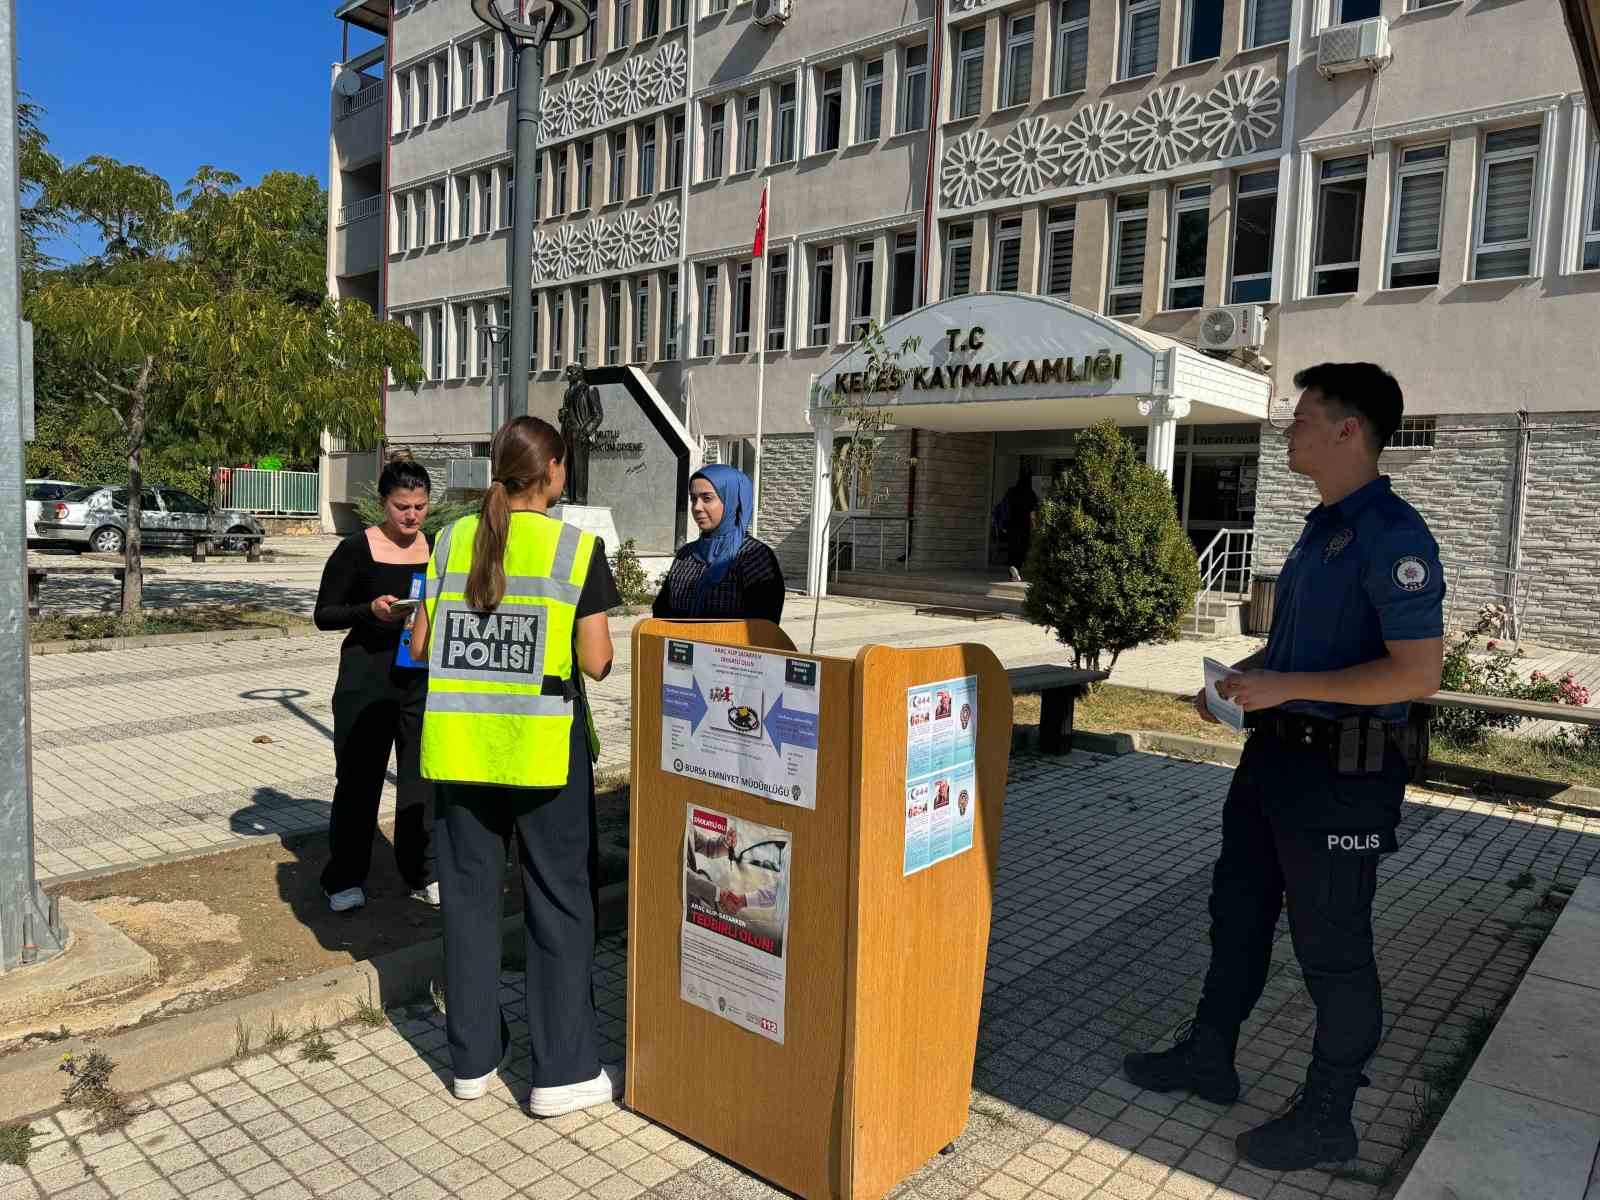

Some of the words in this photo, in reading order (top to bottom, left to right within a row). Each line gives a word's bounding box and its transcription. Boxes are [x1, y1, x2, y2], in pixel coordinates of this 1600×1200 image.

[945, 326, 985, 352] T.C
[912, 349, 1123, 390] KAYMAKAMLIĞI
[448, 612, 536, 642] TRAFİK
[447, 640, 533, 671] POLİSİ
[685, 763, 707, 776] BURSA
[708, 769, 740, 785] EMNİYET
[741, 777, 790, 797] MÜDÜRLÜĞÜ
[762, 1017, 778, 1034] 112
